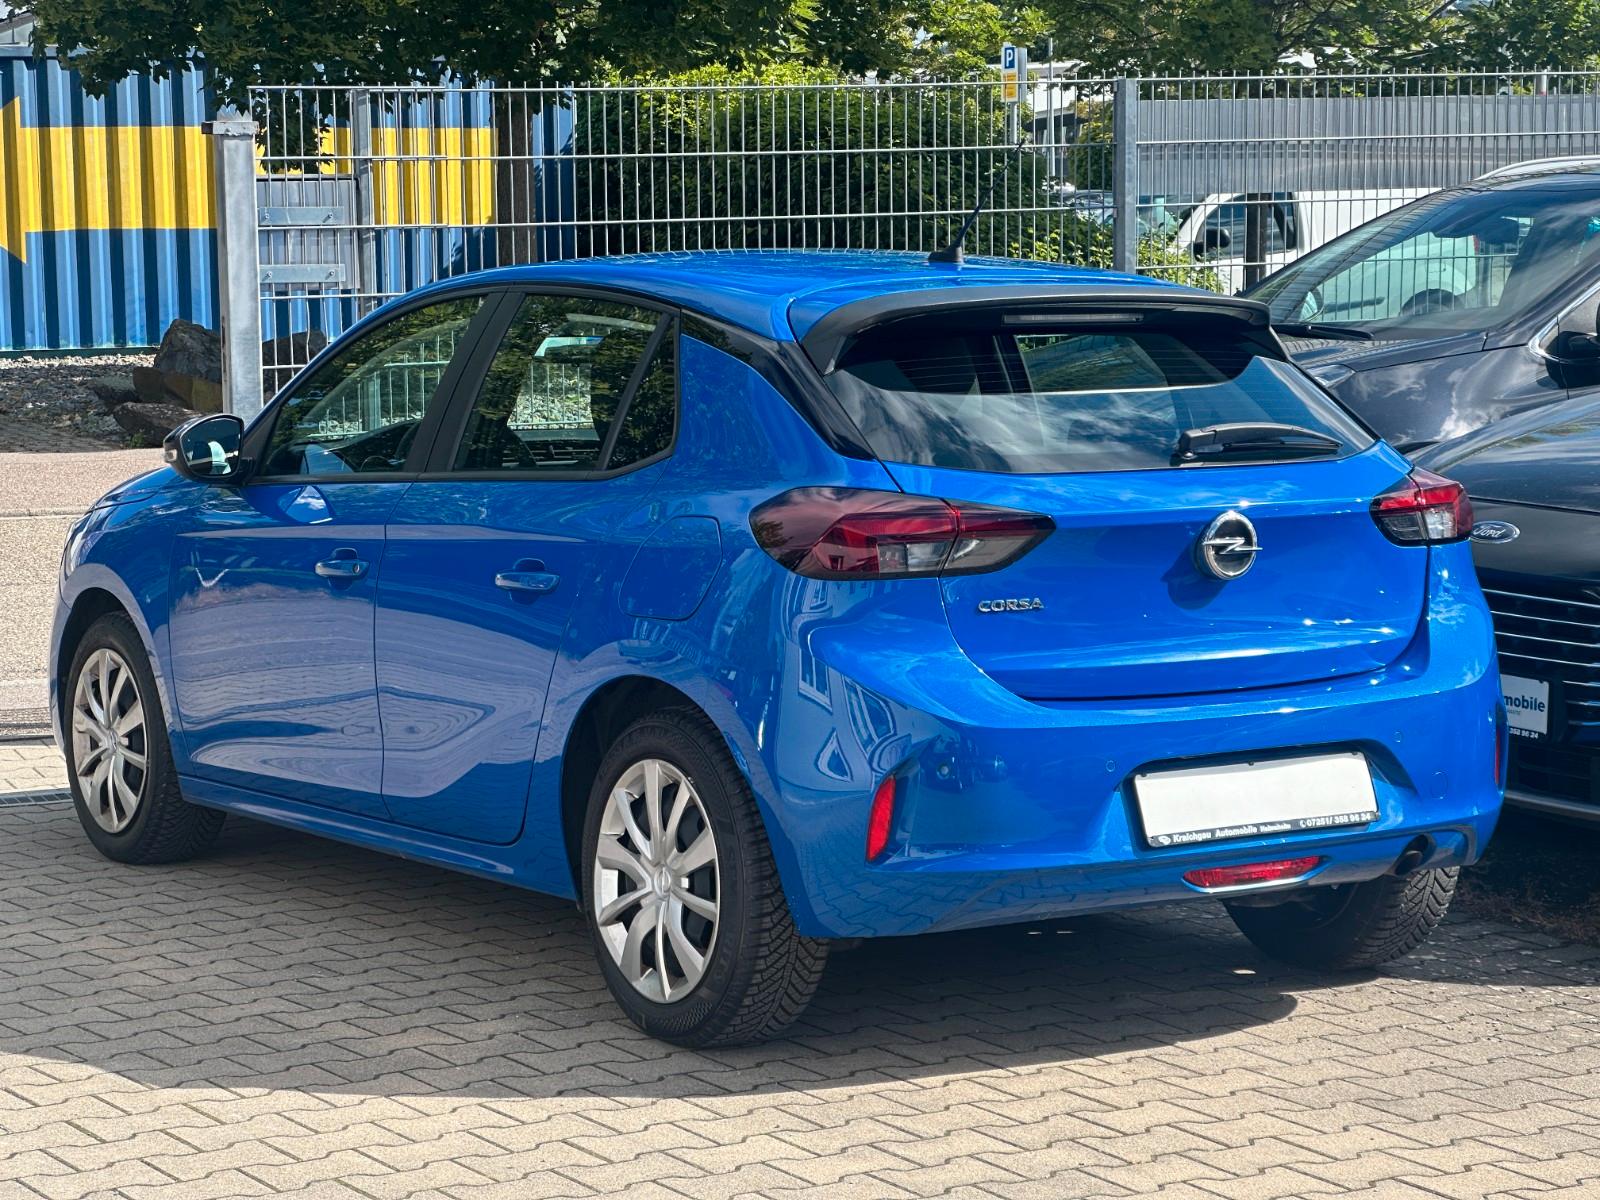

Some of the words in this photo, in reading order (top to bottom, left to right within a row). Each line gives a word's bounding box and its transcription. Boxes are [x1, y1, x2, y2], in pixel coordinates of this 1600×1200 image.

[1006, 49, 1014, 67] P
[1473, 525, 1506, 538] Ford
[978, 597, 1045, 612] CORSA
[1172, 831, 1212, 843] Kraichgau
[1215, 825, 1258, 838] Automobile
